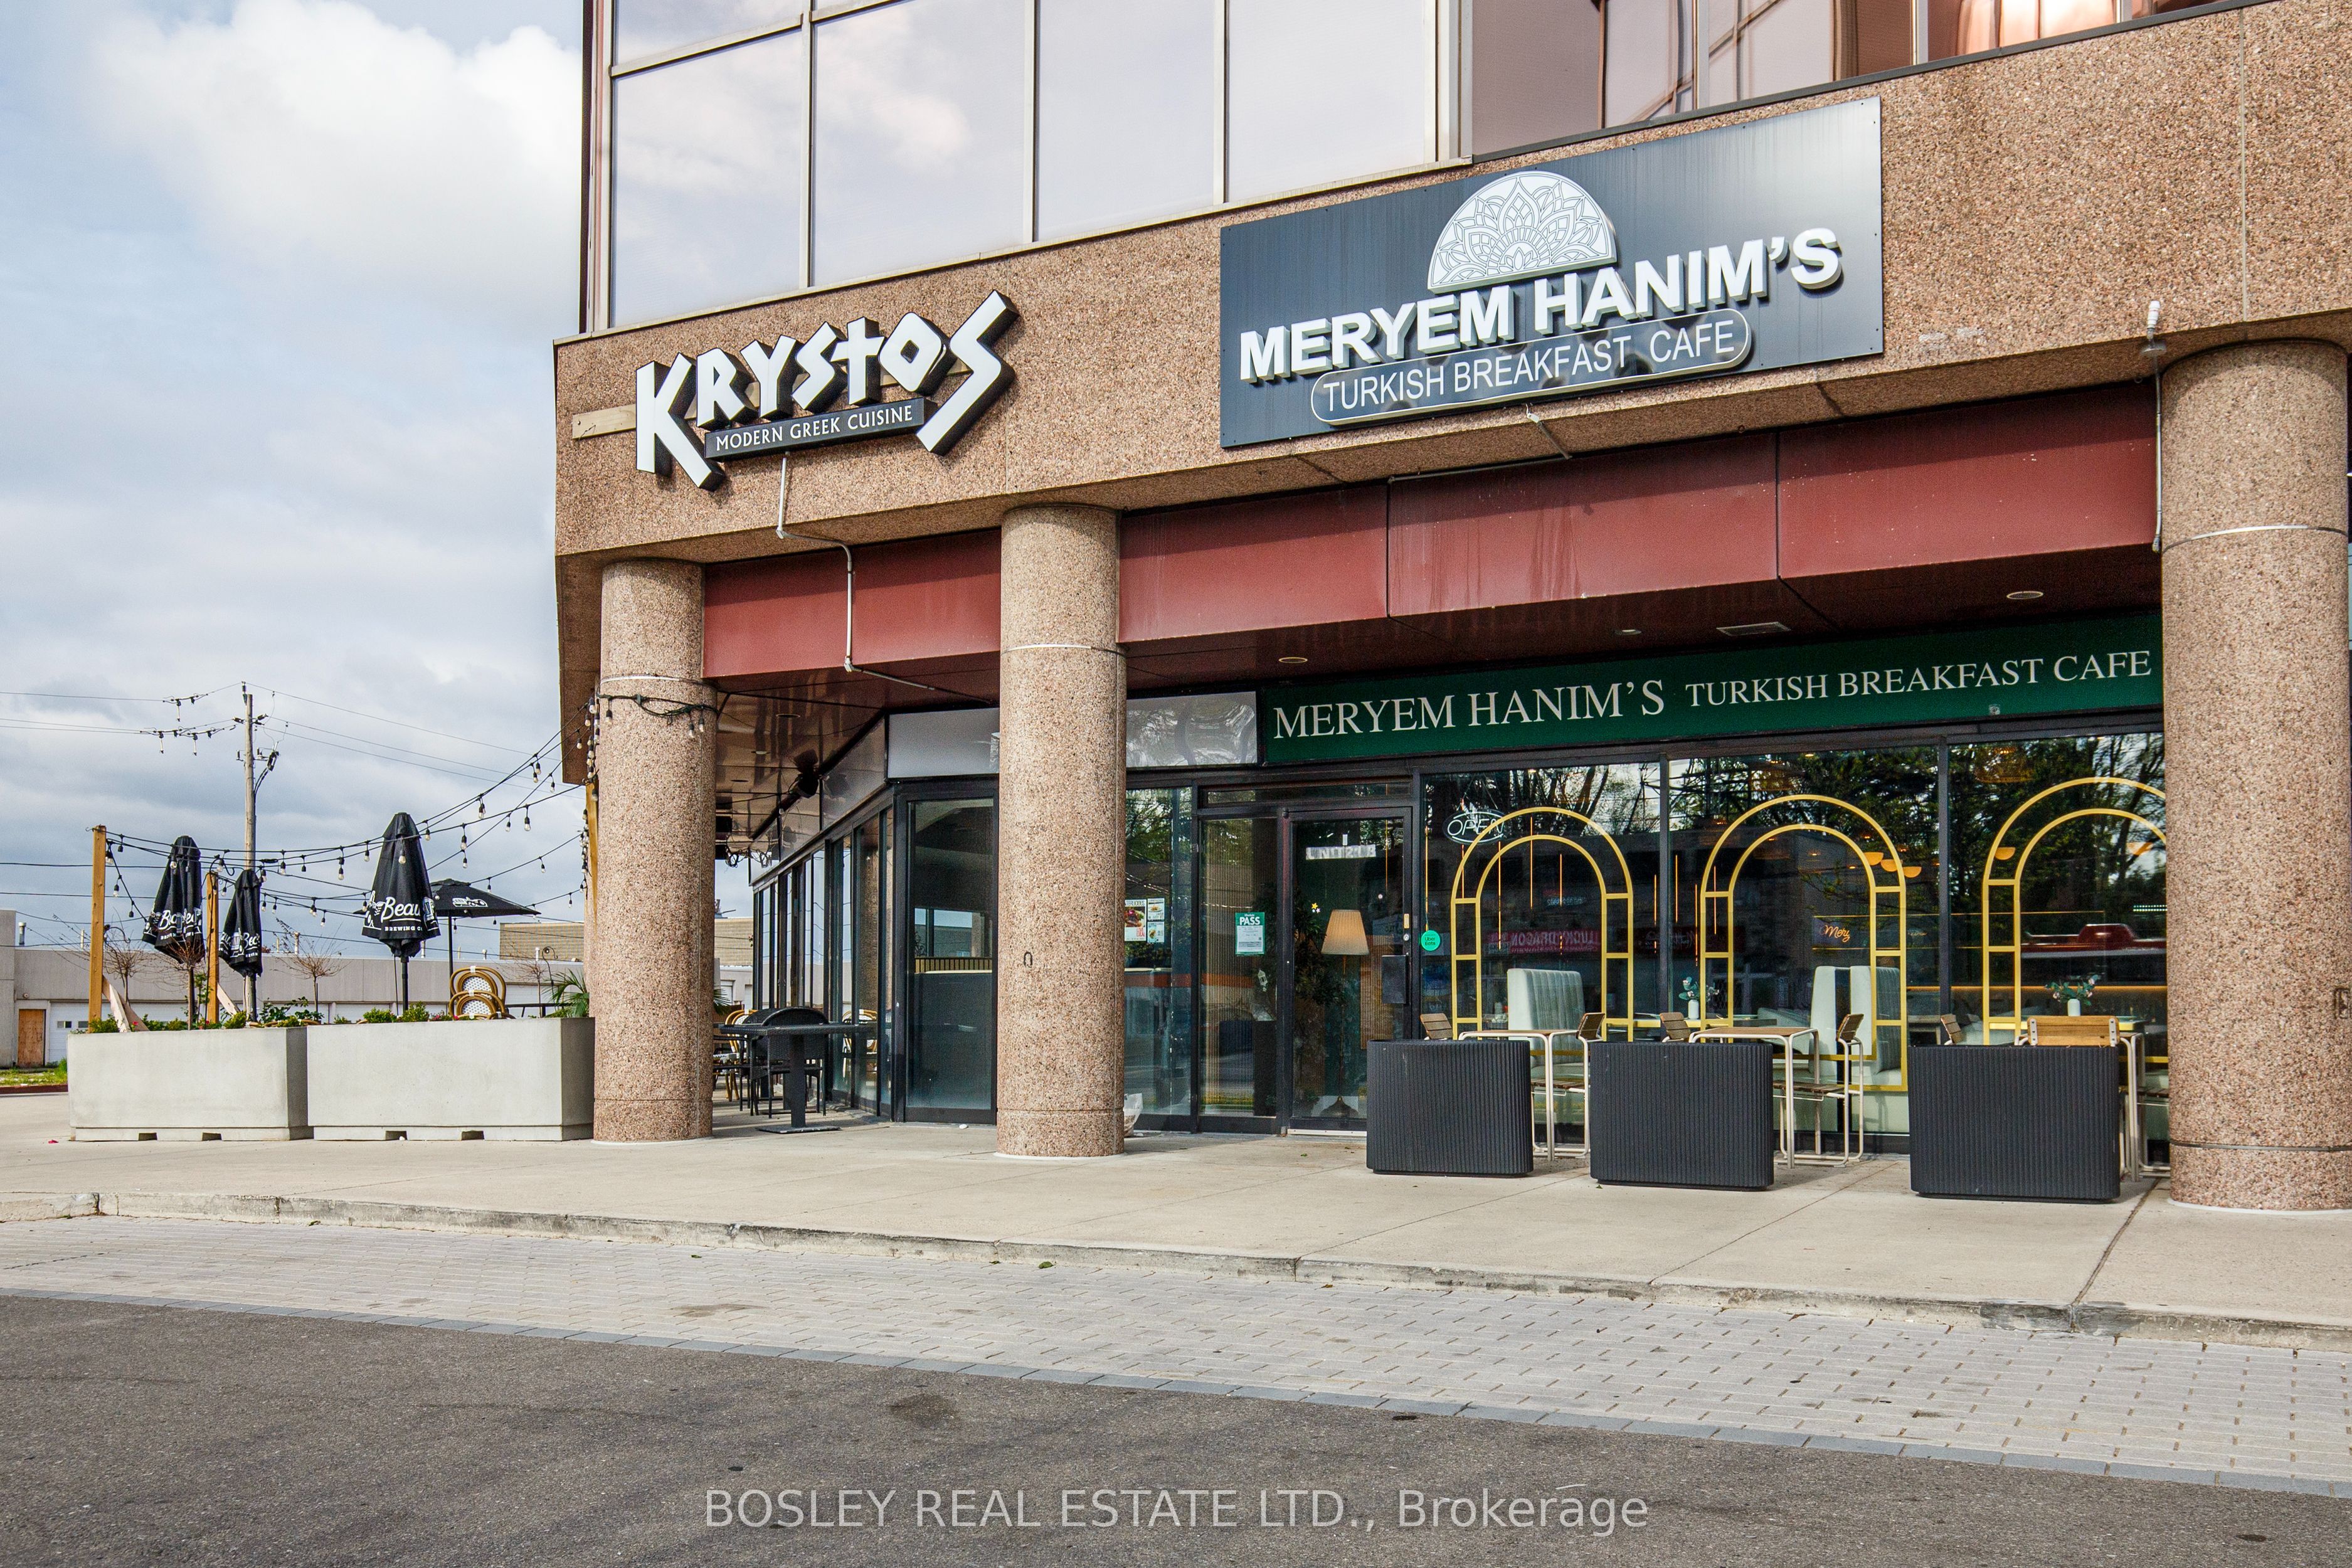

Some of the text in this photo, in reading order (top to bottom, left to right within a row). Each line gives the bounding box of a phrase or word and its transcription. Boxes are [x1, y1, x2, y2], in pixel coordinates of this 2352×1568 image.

[1239, 226, 1843, 384] MERYEM HANIM'S
[1322, 319, 1735, 413] TURKISH BREAKFAST CAFE
[716, 404, 913, 452] MODERN GREEK CUISINE
[1273, 650, 2152, 739] MERYEM HANIM'S TURKISH BREAKFAST CAFE
[1447, 818, 1505, 835] OPEN
[1239, 916, 1261, 926] PASS
